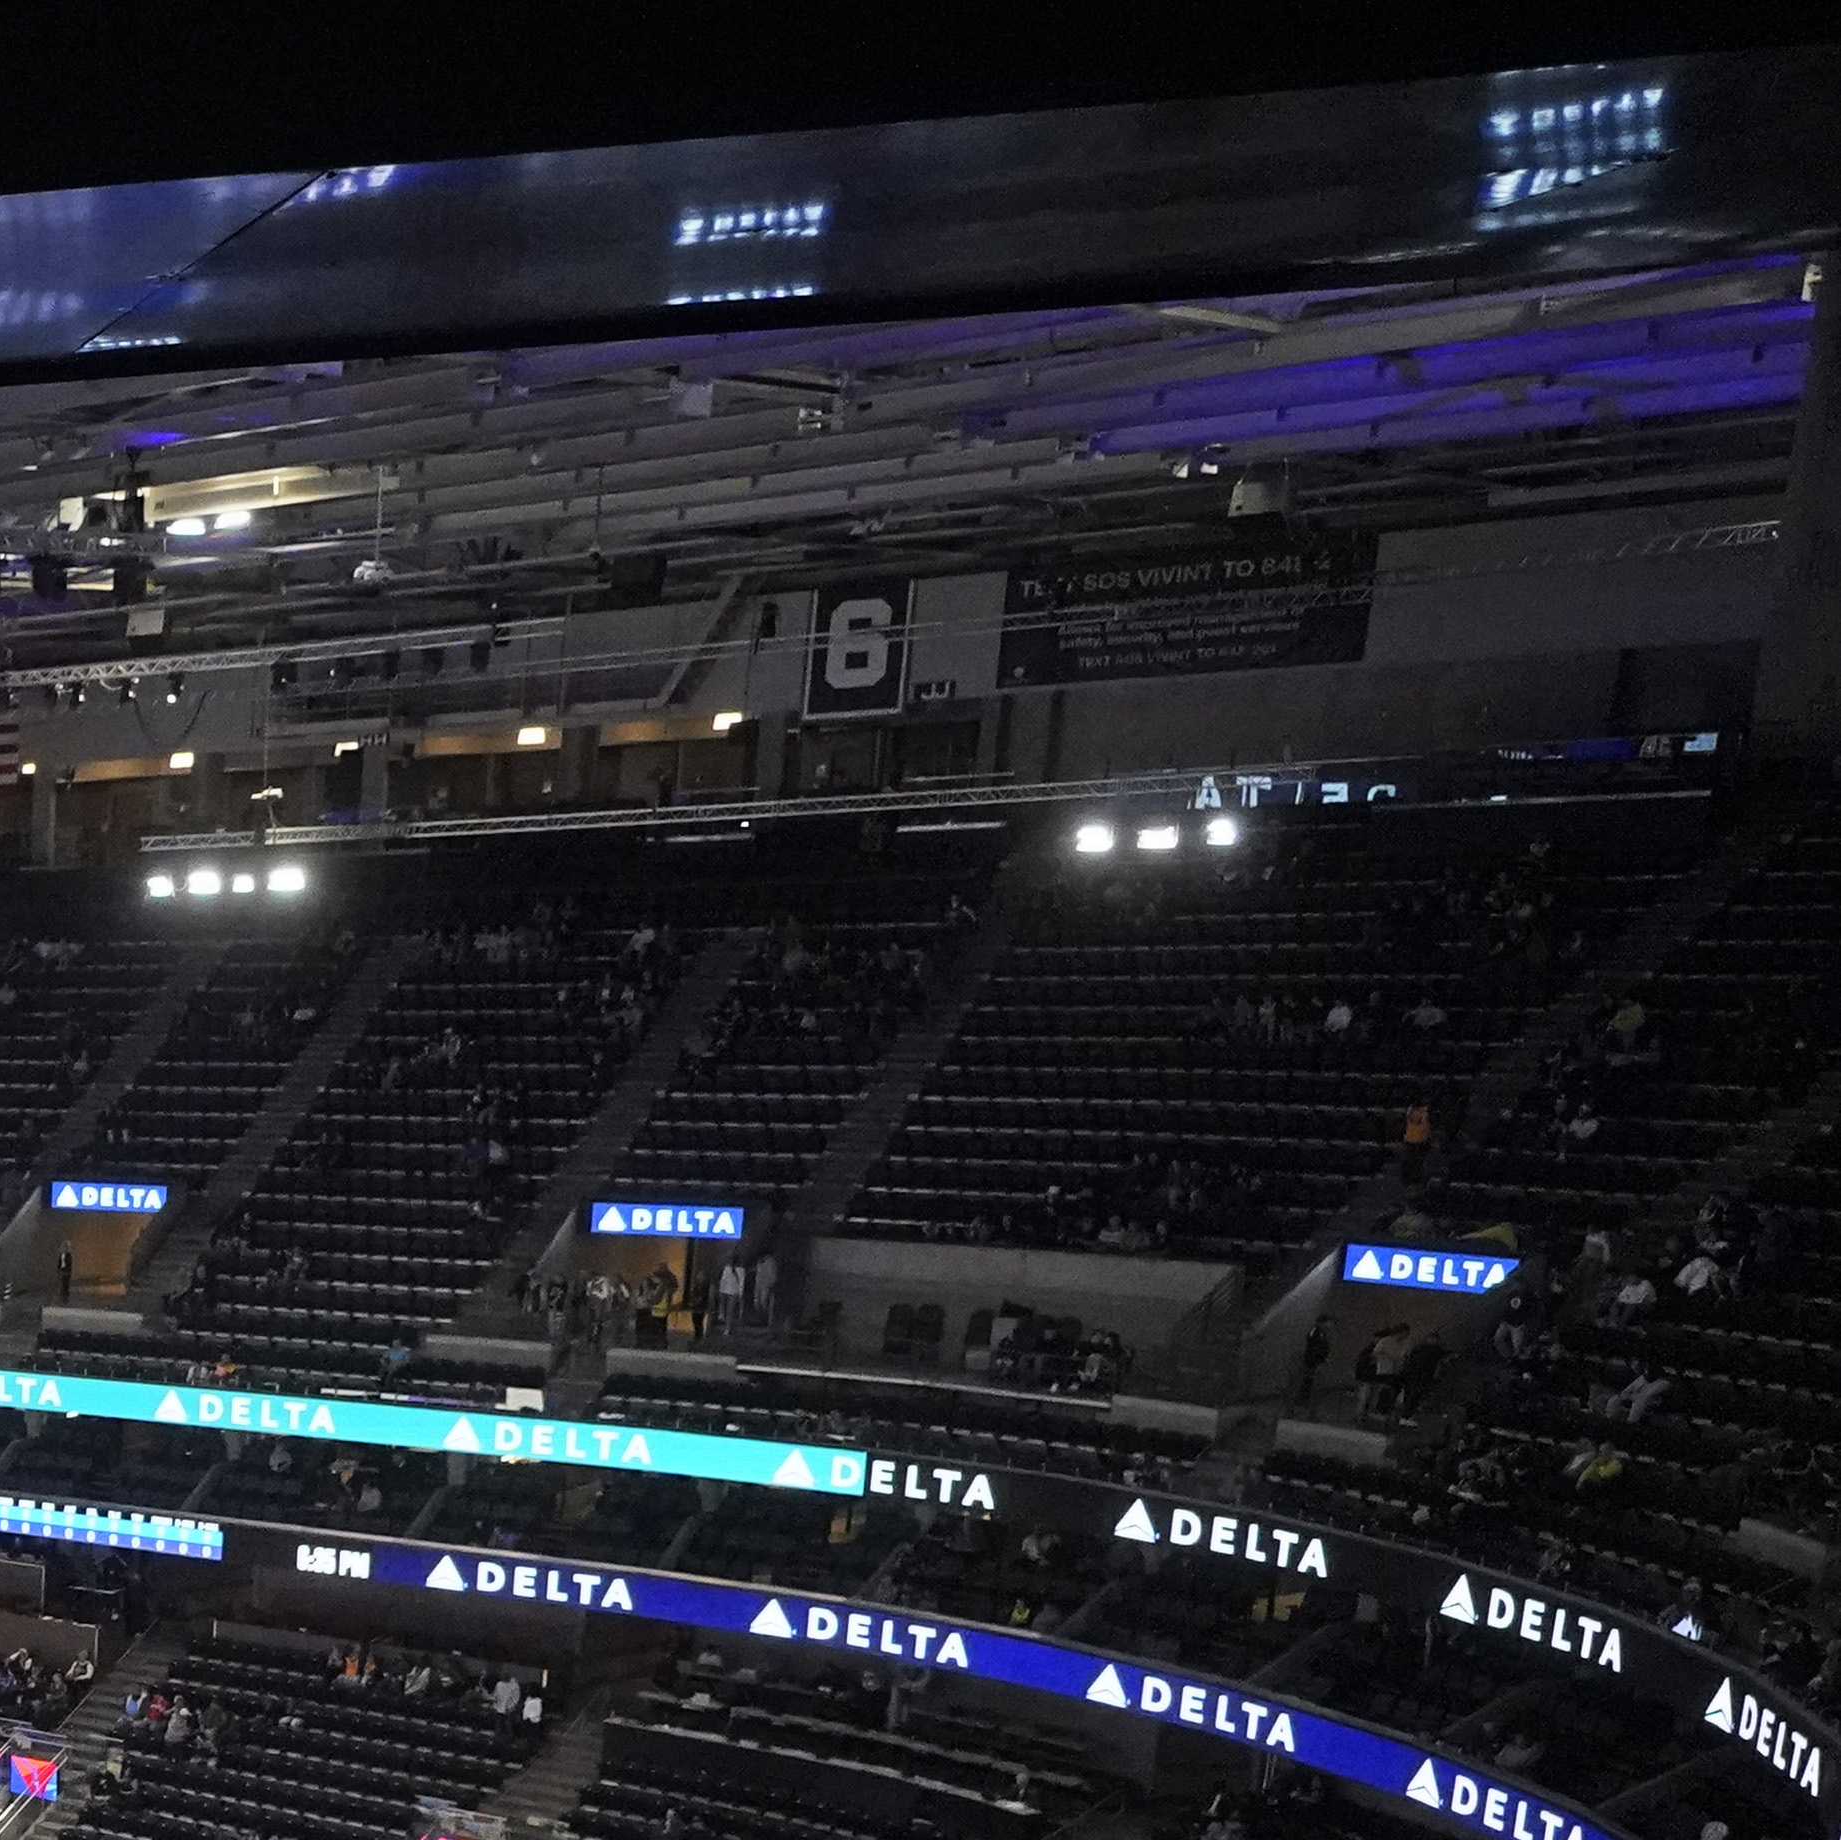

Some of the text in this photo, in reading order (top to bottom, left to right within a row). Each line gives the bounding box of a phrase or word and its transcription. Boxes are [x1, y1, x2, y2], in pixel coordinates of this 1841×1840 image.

[826, 599, 896, 690] 6
[80, 1183, 163, 1209] DELTA
[631, 1207, 735, 1236] DELTA
[1388, 1253, 1508, 1290] DELTA
[198, 1394, 337, 1437] DELTA
[494, 1419, 652, 1468] DELTA
[829, 1455, 995, 1512] DELTA
[339, 1549, 370, 1579] PM
[1170, 1506, 1328, 1581] DELTA
[477, 1560, 634, 1612] DELTA
[807, 1606, 970, 1670] DELTA
[1486, 1584, 1623, 1674] DELTA
[1140, 1677, 1296, 1753] DELTA
[1738, 1693, 1822, 1799] DELTA
